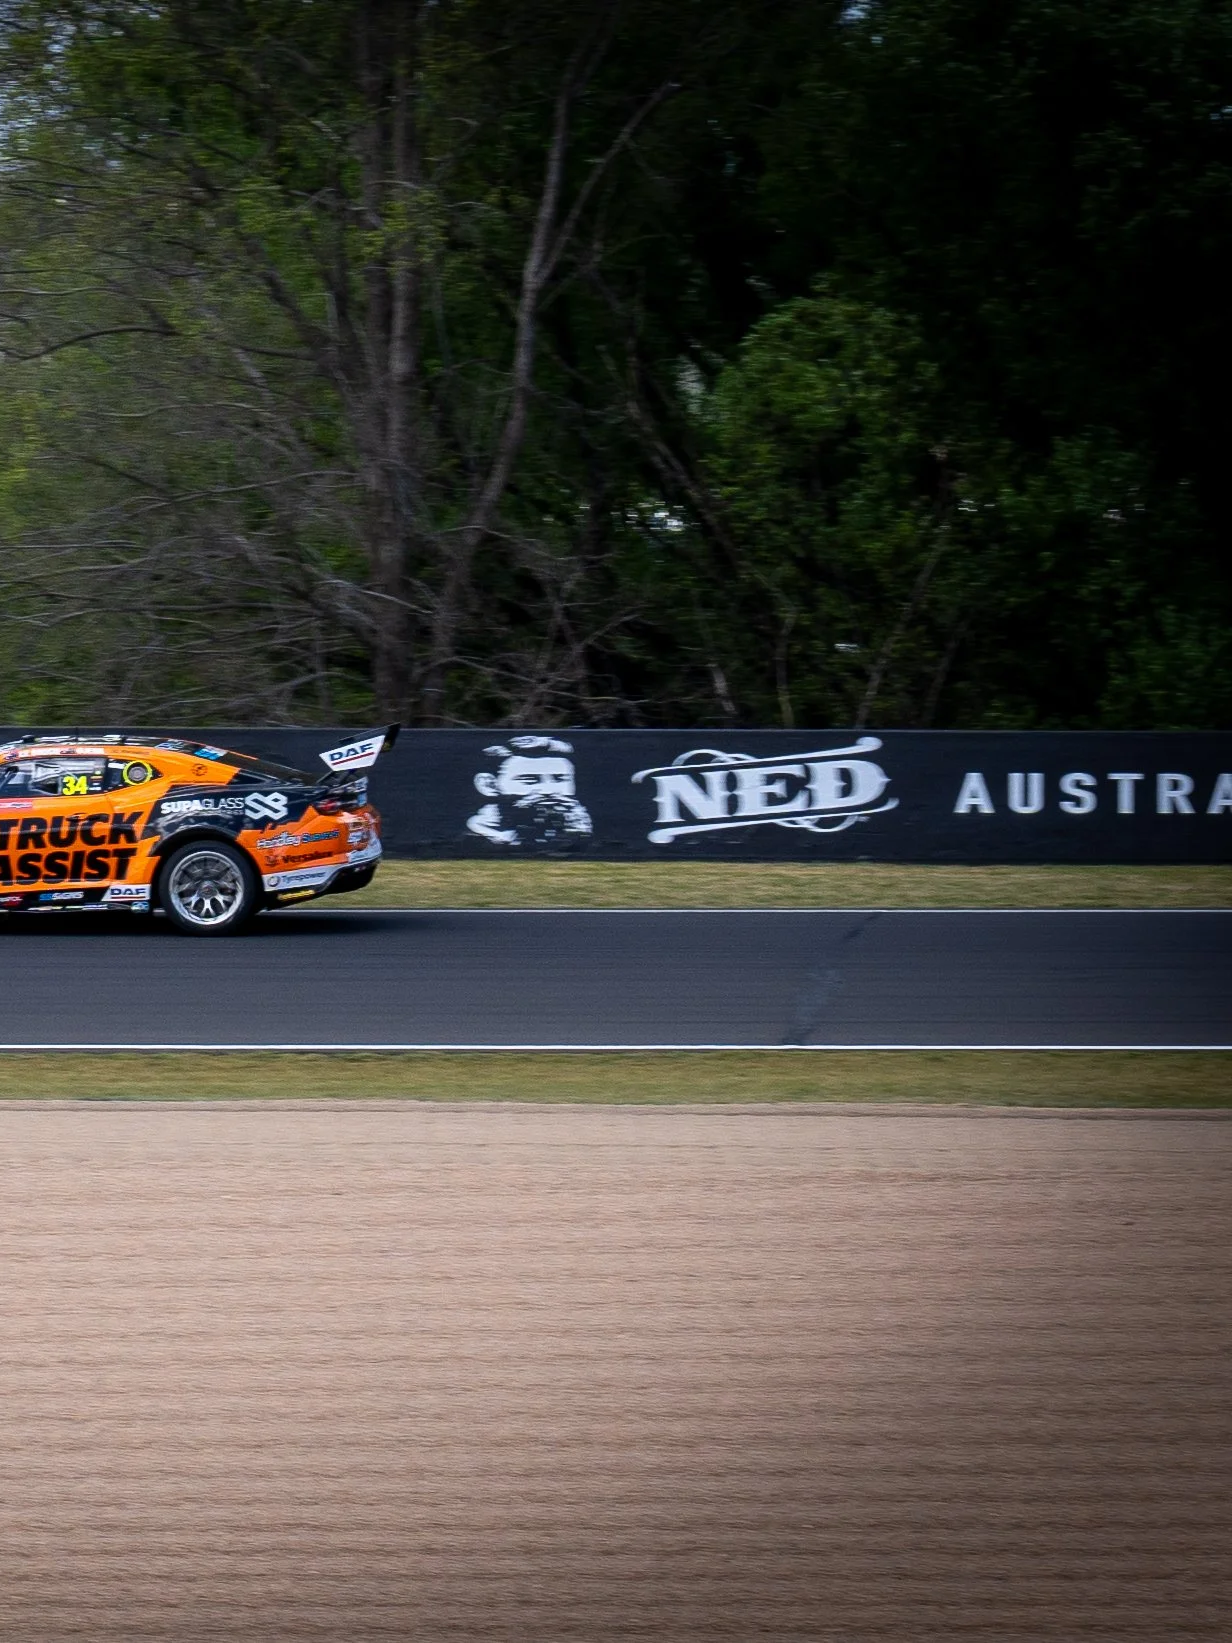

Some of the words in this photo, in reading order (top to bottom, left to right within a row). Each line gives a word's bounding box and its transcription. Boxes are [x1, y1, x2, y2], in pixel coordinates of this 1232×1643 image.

[329, 743, 374, 762] DAF
[62, 775, 89, 796] 34
[653, 758, 892, 825] NED
[160, 797, 245, 815] SUPAGLASS
[110, 888, 147, 896] DAF
